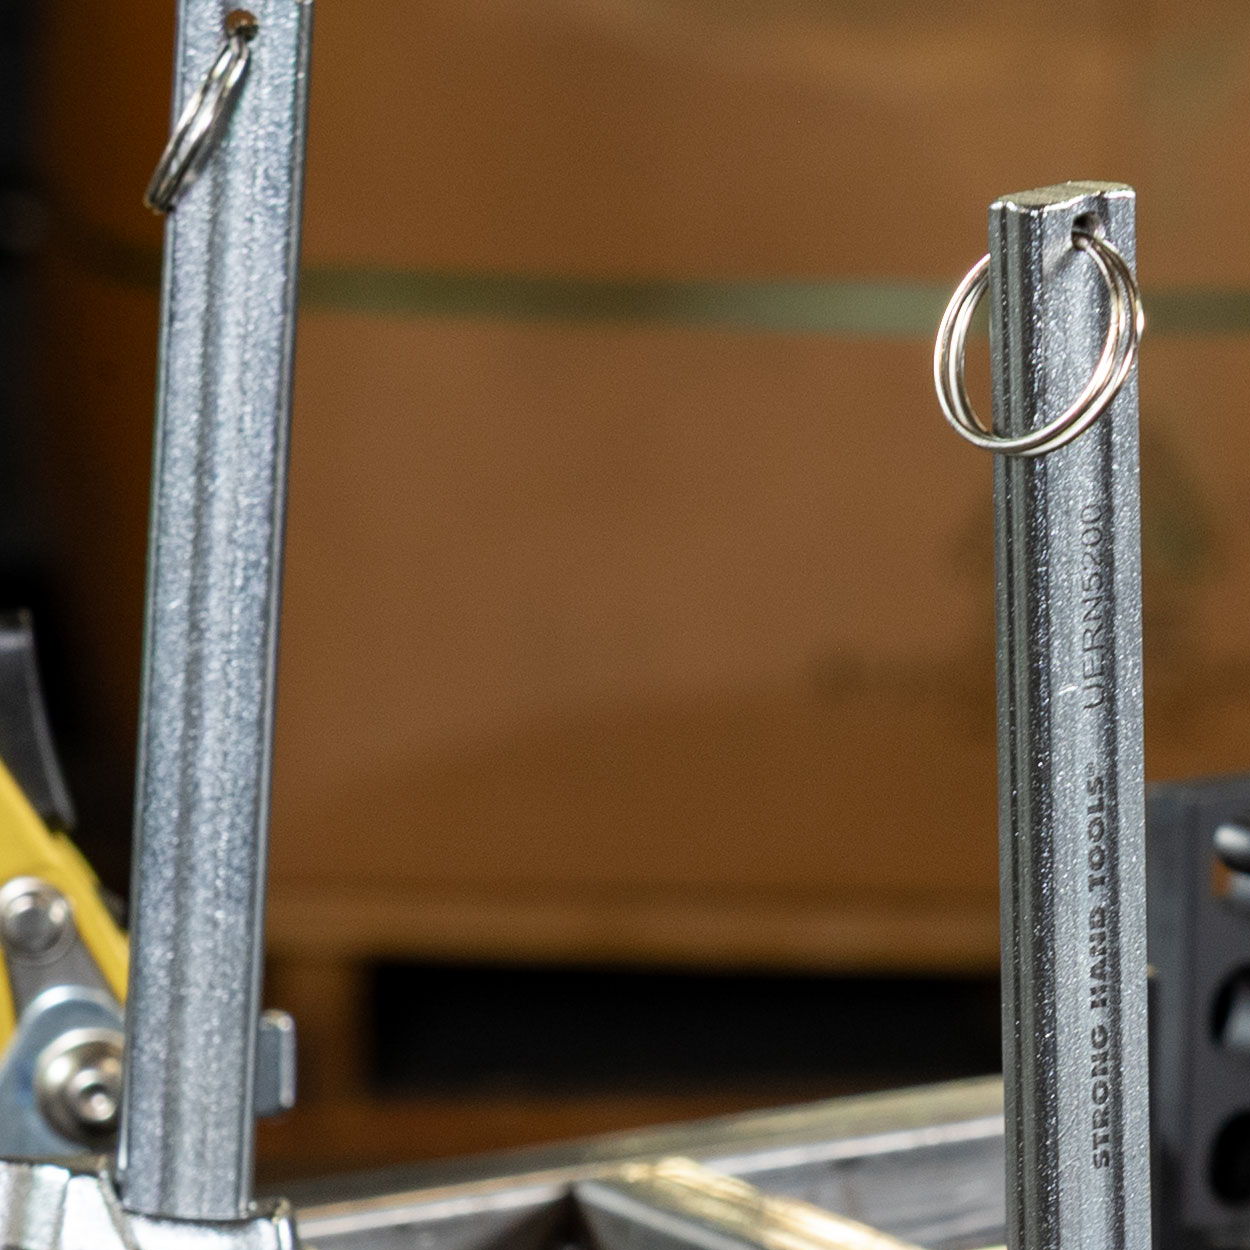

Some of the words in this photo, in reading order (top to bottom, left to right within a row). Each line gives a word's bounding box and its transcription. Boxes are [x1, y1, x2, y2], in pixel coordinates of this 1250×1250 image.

[1080, 503, 1105, 710] UERN5200
[1088, 906, 1109, 1008] HAND
[1090, 1025, 1111, 1169] STRONG
